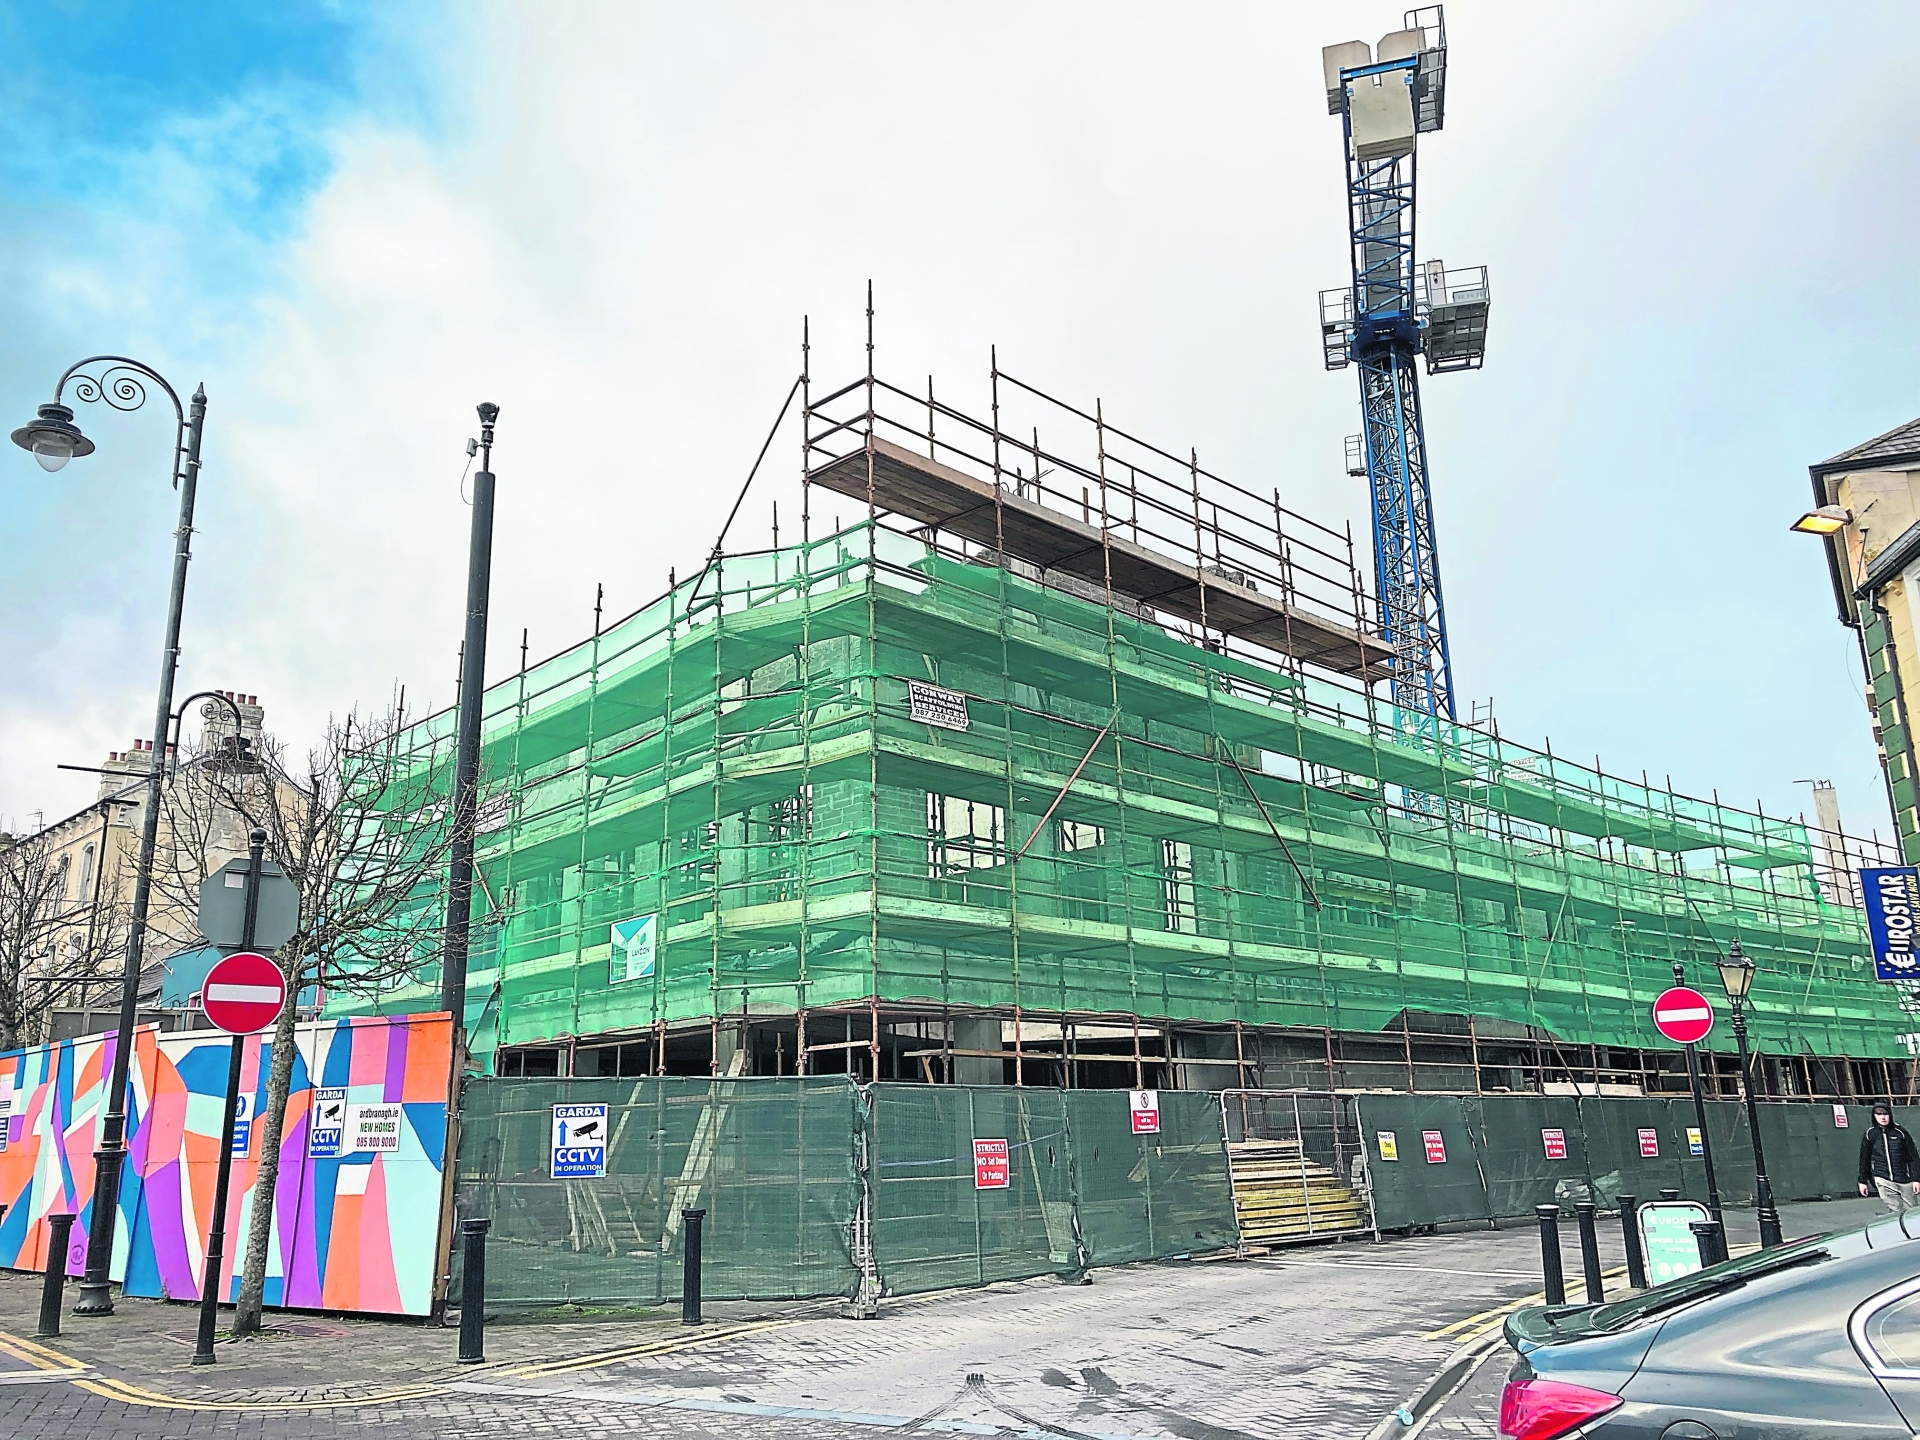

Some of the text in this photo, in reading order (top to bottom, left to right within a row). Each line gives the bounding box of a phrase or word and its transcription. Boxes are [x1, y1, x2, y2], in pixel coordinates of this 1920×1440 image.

[913, 686, 962, 704] CONWAY
[915, 708, 929, 717] 087
[931, 712, 946, 720] 250
[947, 716, 967, 726] 6469
[316, 1090, 343, 1100] GARDA
[557, 1107, 602, 1117] GARDA
[360, 1121, 396, 1133] NEW HOMES
[312, 1129, 339, 1144] CCTV
[976, 1143, 1005, 1152] STRICTLY
[556, 1147, 600, 1163] CCTV
[563, 1164, 602, 1172] OPERATION
